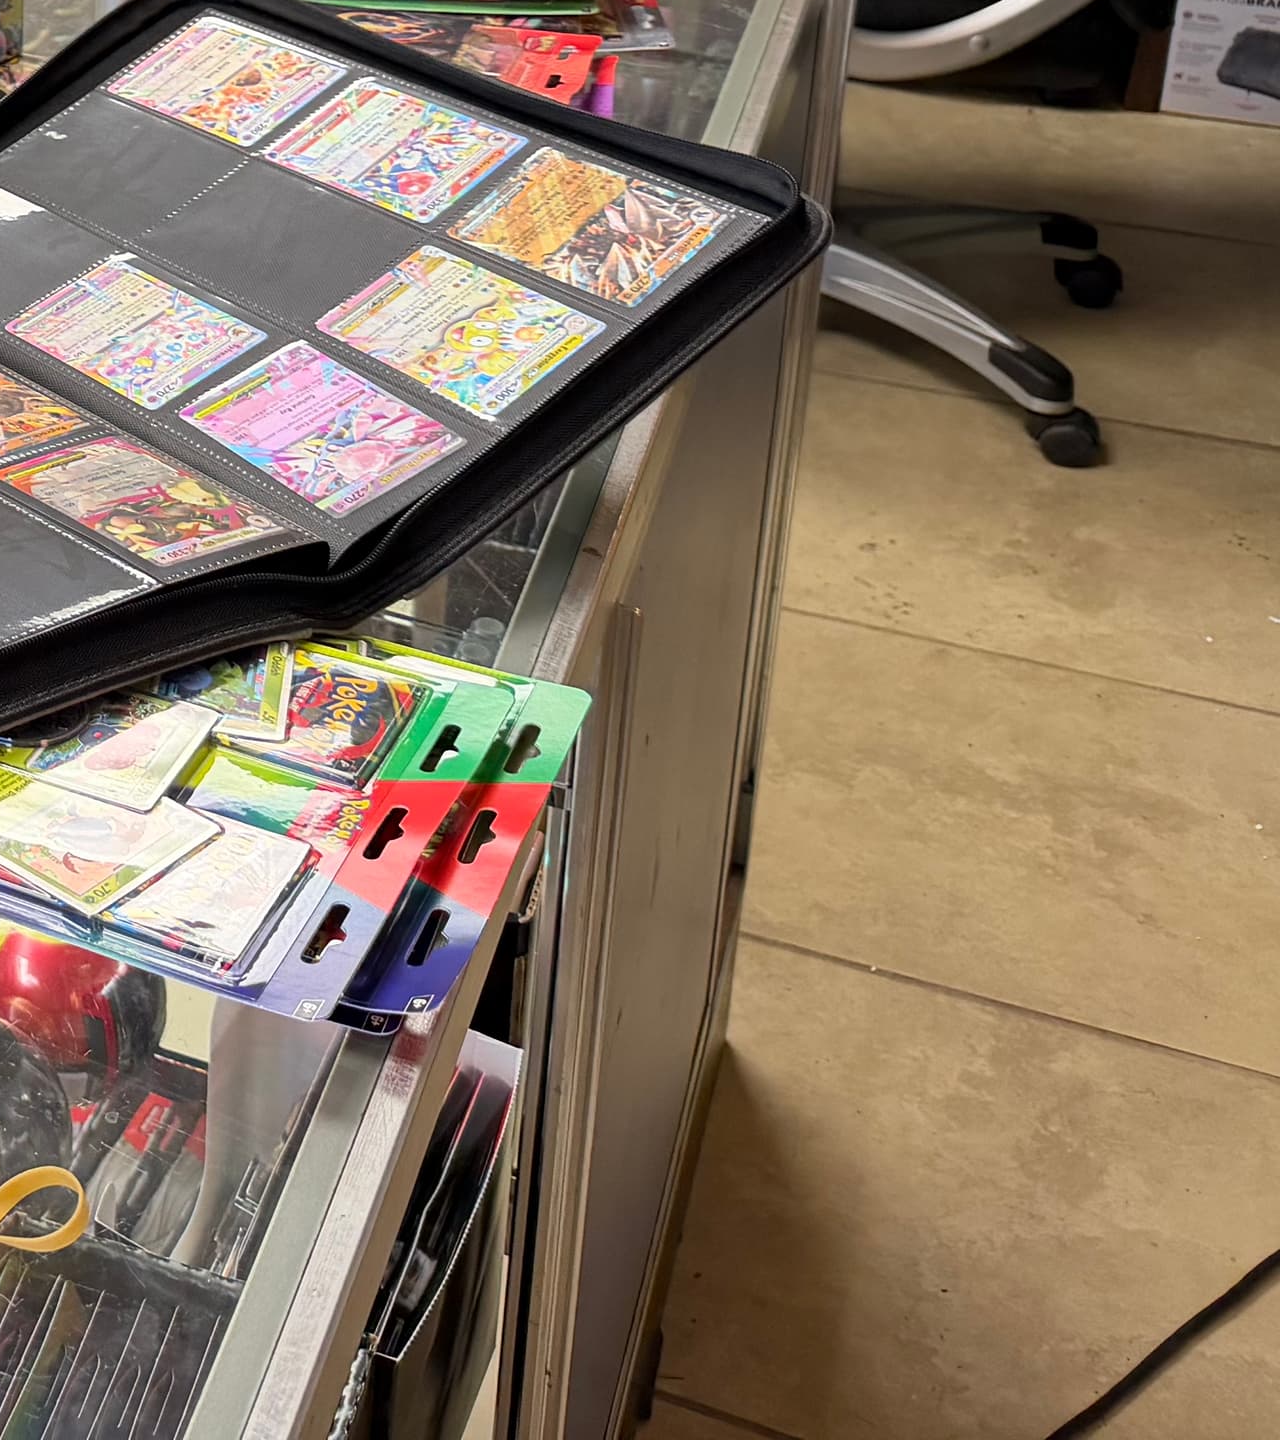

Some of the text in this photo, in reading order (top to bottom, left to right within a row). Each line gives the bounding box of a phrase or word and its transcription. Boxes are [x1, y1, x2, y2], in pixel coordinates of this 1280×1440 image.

[424, 196, 446, 211] 320
[626, 277, 651, 294] 270
[153, 383, 177, 398] 270
[491, 384, 517, 402] 300
[340, 488, 366, 505] 270
[95, 884, 113, 898] 70
